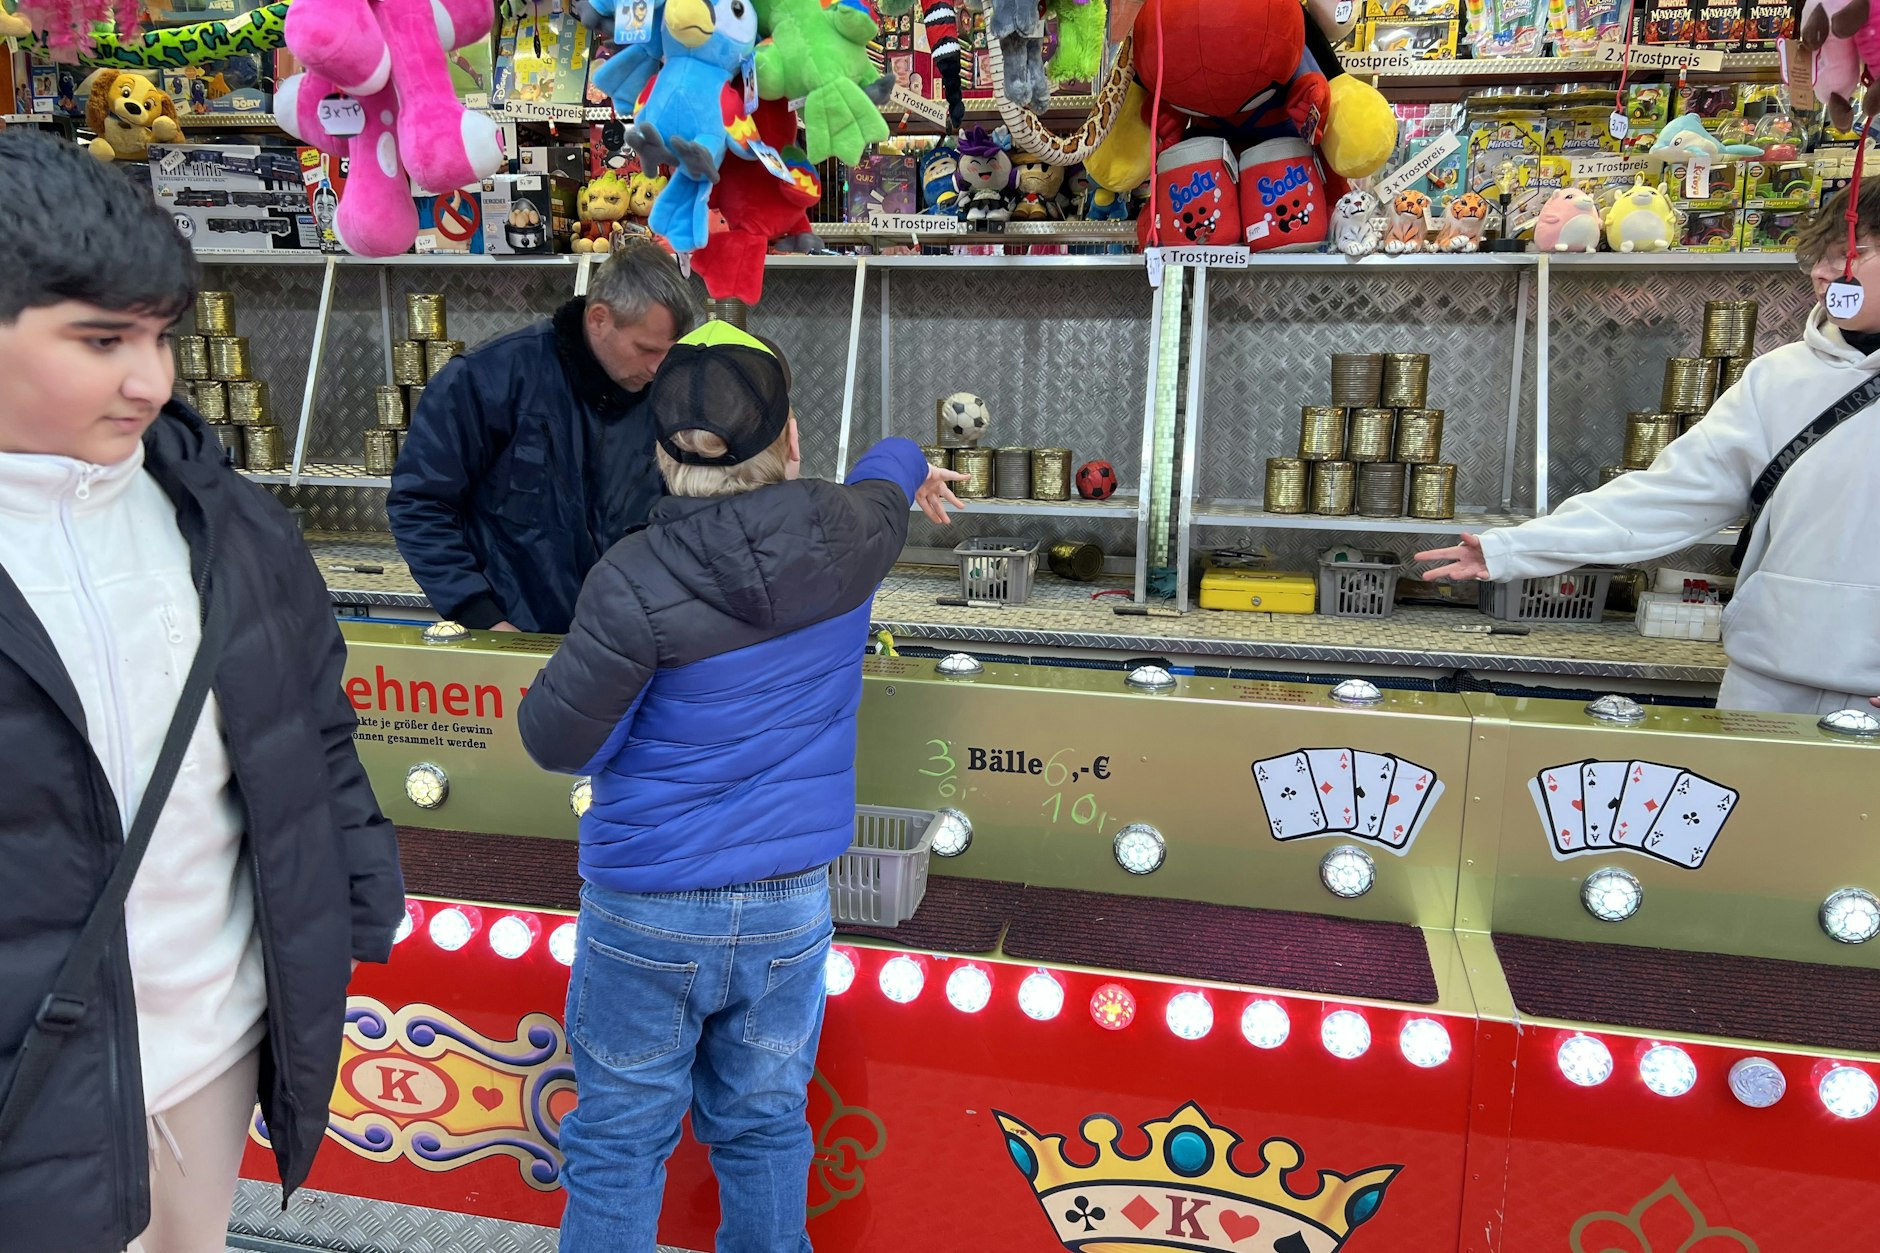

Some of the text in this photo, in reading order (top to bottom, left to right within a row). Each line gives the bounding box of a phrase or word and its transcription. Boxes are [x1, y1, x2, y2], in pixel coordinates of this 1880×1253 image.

[1650, 8, 1693, 22] MAYHEM
[1700, 7, 1743, 21] MAYHEM
[1750, 6, 1793, 20] MAYHEM
[1337, 54, 1409, 69] Trostpreis
[1605, 48, 1701, 69] 2 x Trostpreis
[493, 66, 512, 102] Disney
[232, 99, 261, 108] DORY
[894, 91, 945, 121] x Trostpreis
[505, 101, 583, 119] 6 x Trostpreis
[1500, 130, 1511, 139] ME
[1577, 130, 1588, 139] ME
[1487, 139, 1524, 149] Mineez
[1563, 139, 1600, 148] Mineez
[1384, 145, 1446, 195] 3 x Trostpreis
[1579, 164, 1585, 174] 2
[1596, 160, 1649, 174] Trostpreis
[855, 174, 874, 182] QUIZ
[1526, 177, 1562, 188] Mineez
[1603, 175, 1635, 185] Minee
[1257, 163, 1309, 207] Soda
[1169, 170, 1216, 213] Soda
[871, 217, 878, 228] 4
[892, 217, 956, 232] Trostpreis
[1170, 250, 1246, 264] Trostpreis
[381, 717, 391, 731] je
[394, 719, 428, 732] größer
[431, 721, 449, 732] der
[452, 722, 493, 735] Gewinn
[387, 733, 444, 747] gesammelt
[447, 737, 487, 750] werden
[918, 739, 956, 777] 3
[967, 747, 1044, 775] Bälle
[1295, 756, 1303, 766] A
[1339, 752, 1348, 761] A
[1258, 766, 1266, 774] A
[1382, 762, 1390, 771] A
[1633, 766, 1643, 775] A
[1587, 768, 1596, 777] A
[1418, 774, 1427, 784] A
[1547, 774, 1556, 783] A
[1680, 778, 1690, 788] A
[1722, 794, 1731, 804] A
[1312, 817, 1320, 827] A
[1343, 816, 1352, 825] A
[1275, 826, 1283, 834] A
[1367, 823, 1375, 832] A
[1393, 831, 1401, 840] A
[1591, 834, 1600, 842] A
[1618, 831, 1627, 839] A
[1563, 838, 1572, 846] A
[1651, 838, 1660, 847] A
[1691, 854, 1700, 863] A
[376, 1065, 422, 1105] K
[1165, 1194, 1211, 1241] K
